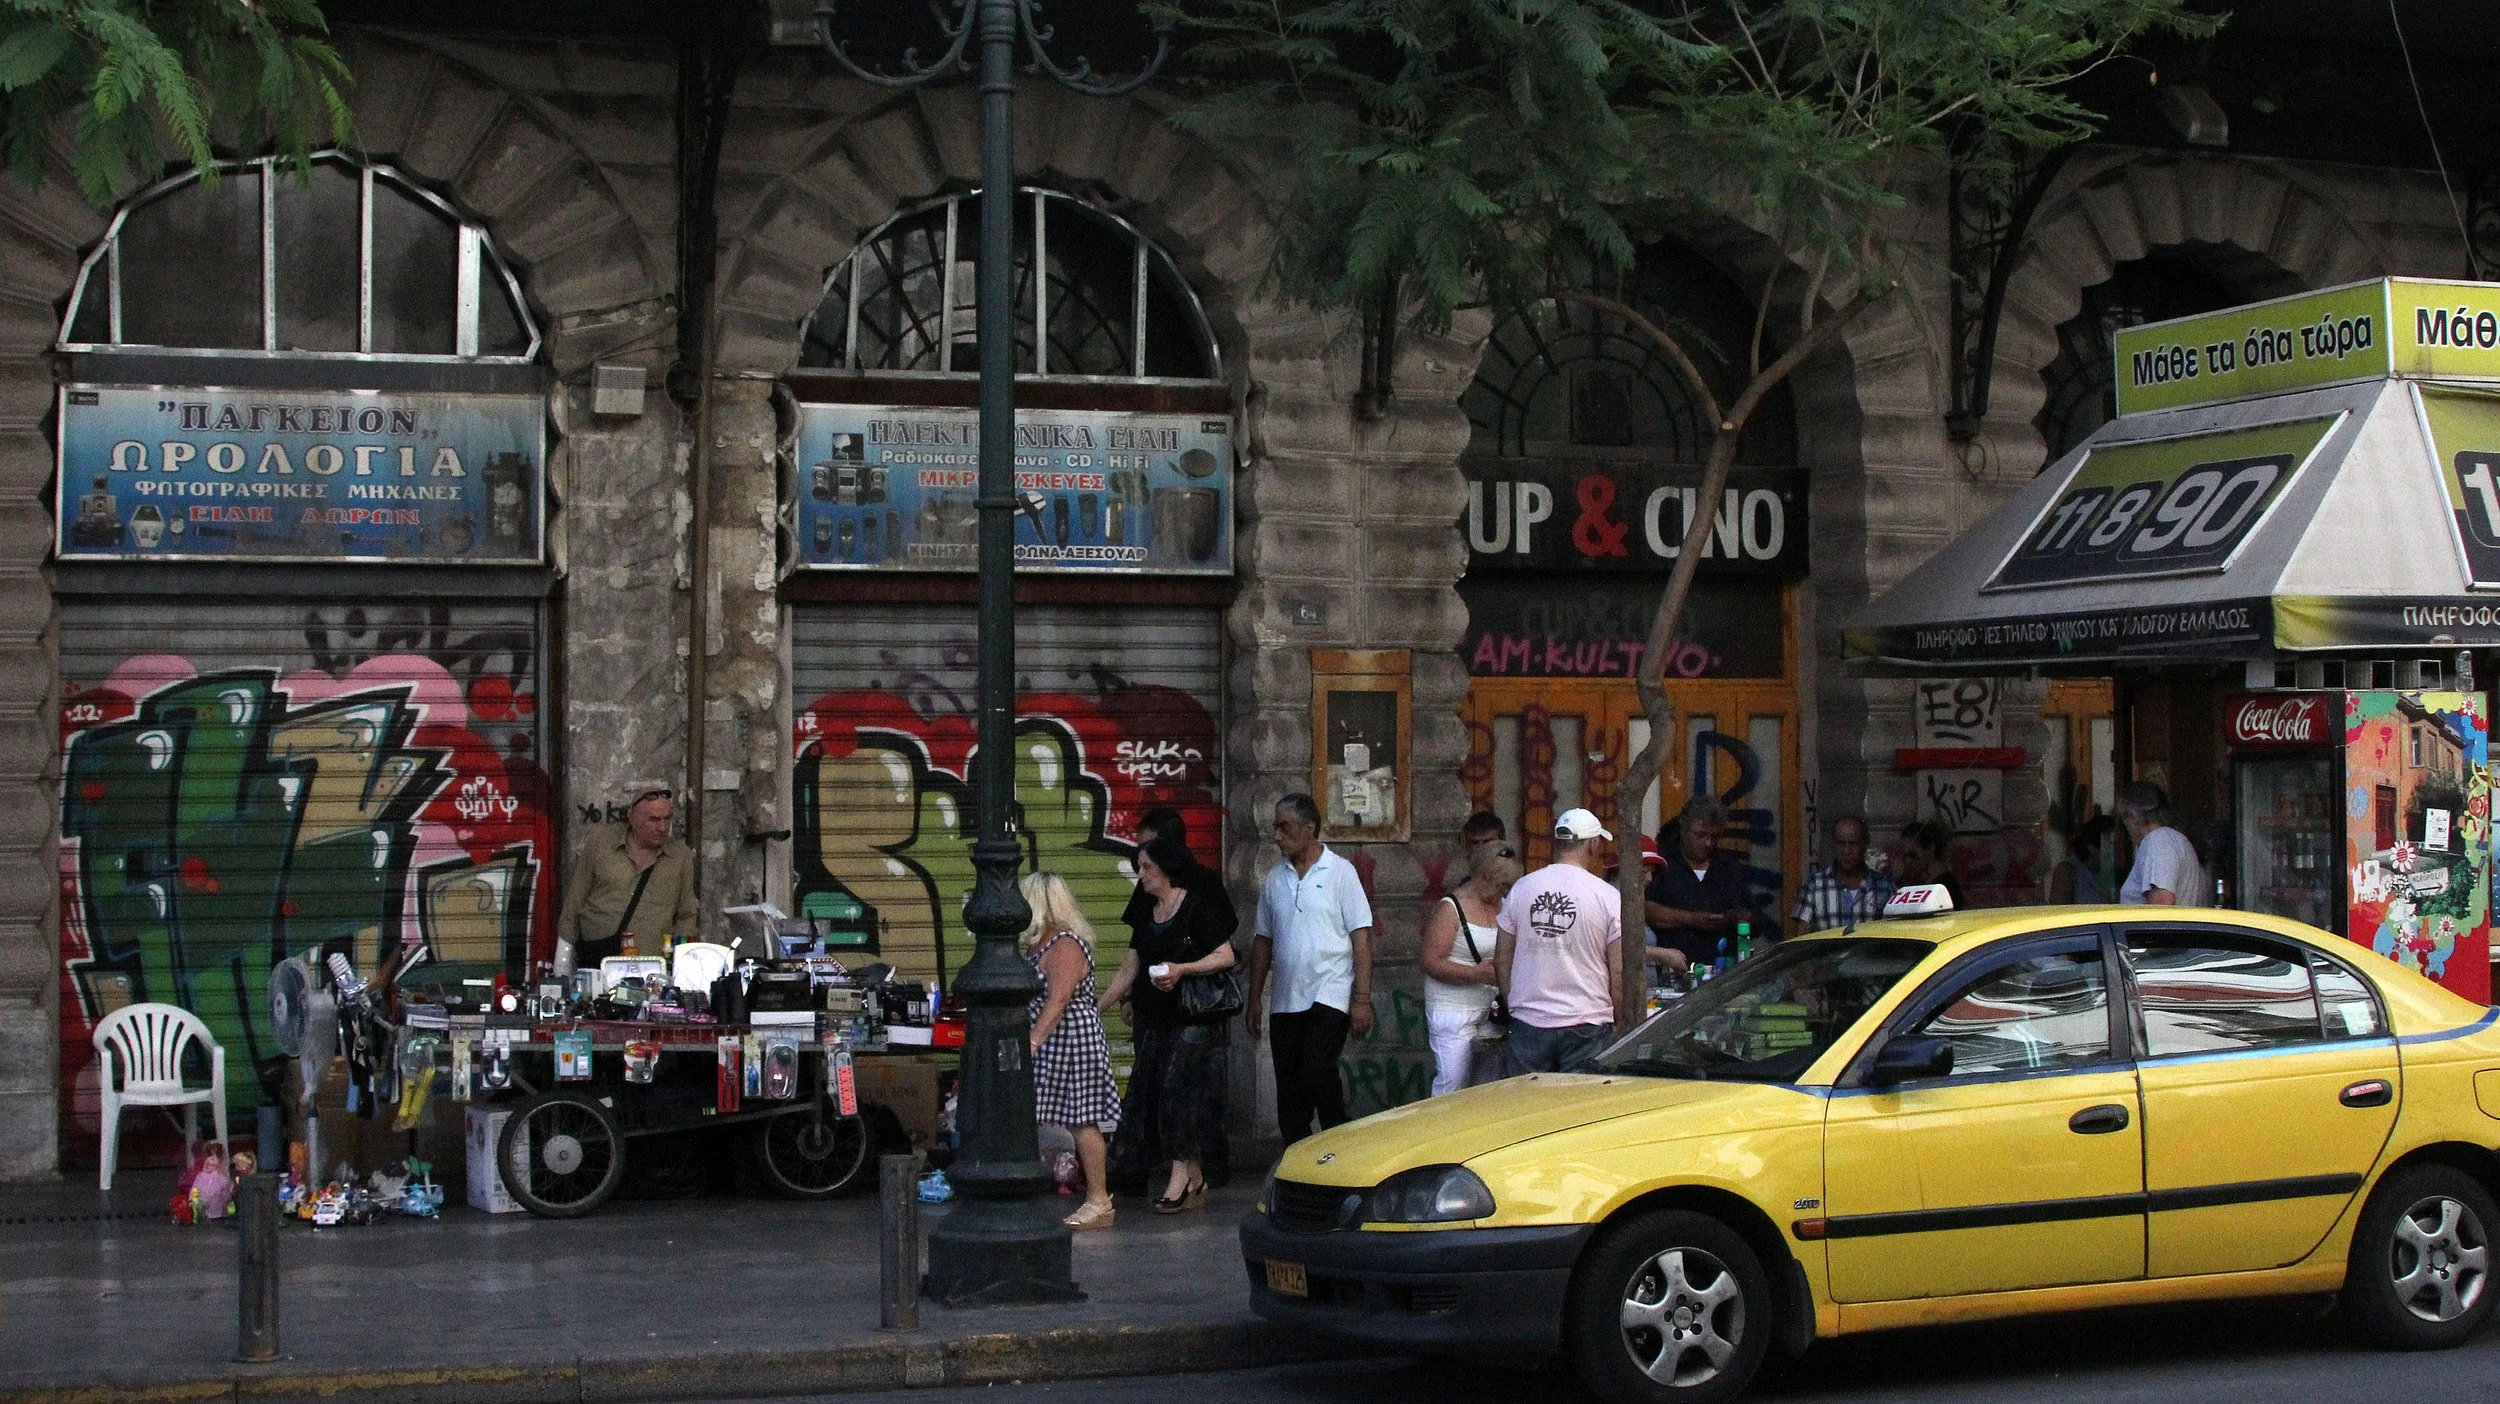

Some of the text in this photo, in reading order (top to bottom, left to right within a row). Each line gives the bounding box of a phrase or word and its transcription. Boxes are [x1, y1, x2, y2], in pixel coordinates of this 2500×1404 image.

[2415, 307, 2500, 349] Μάθ
[2132, 312, 2373, 387] Μάθε τα όλα τώρα
[867, 419, 1097, 450] ΗΛΕΚΤΝΙΚΑ
[1105, 426, 1183, 451] ΕΙΔΗ
[108, 440, 466, 478] ΩΡΟΛΟΓΙΑ
[881, 449, 1049, 467] Ραδιοκασεωνα
[134, 480, 463, 501] ΦΩΤΟΓΡΑΦΙΚΕΣ ΜΗΧΑΝΕΣ
[919, 469, 1106, 491] ΜΙΚΡΣΚΕΥΕΣ
[189, 505, 421, 526] ΕΙΔΗ ΔΩΡΩΝ
[1571, 473, 1630, 559] &
[1644, 485, 1785, 561] CINO
[2463, 463, 2500, 538] 1
[1916, 624, 2001, 650] ΠΛΗΡΟΦΟΙΕΣ
[2235, 698, 2318, 741] Coca-Cola
